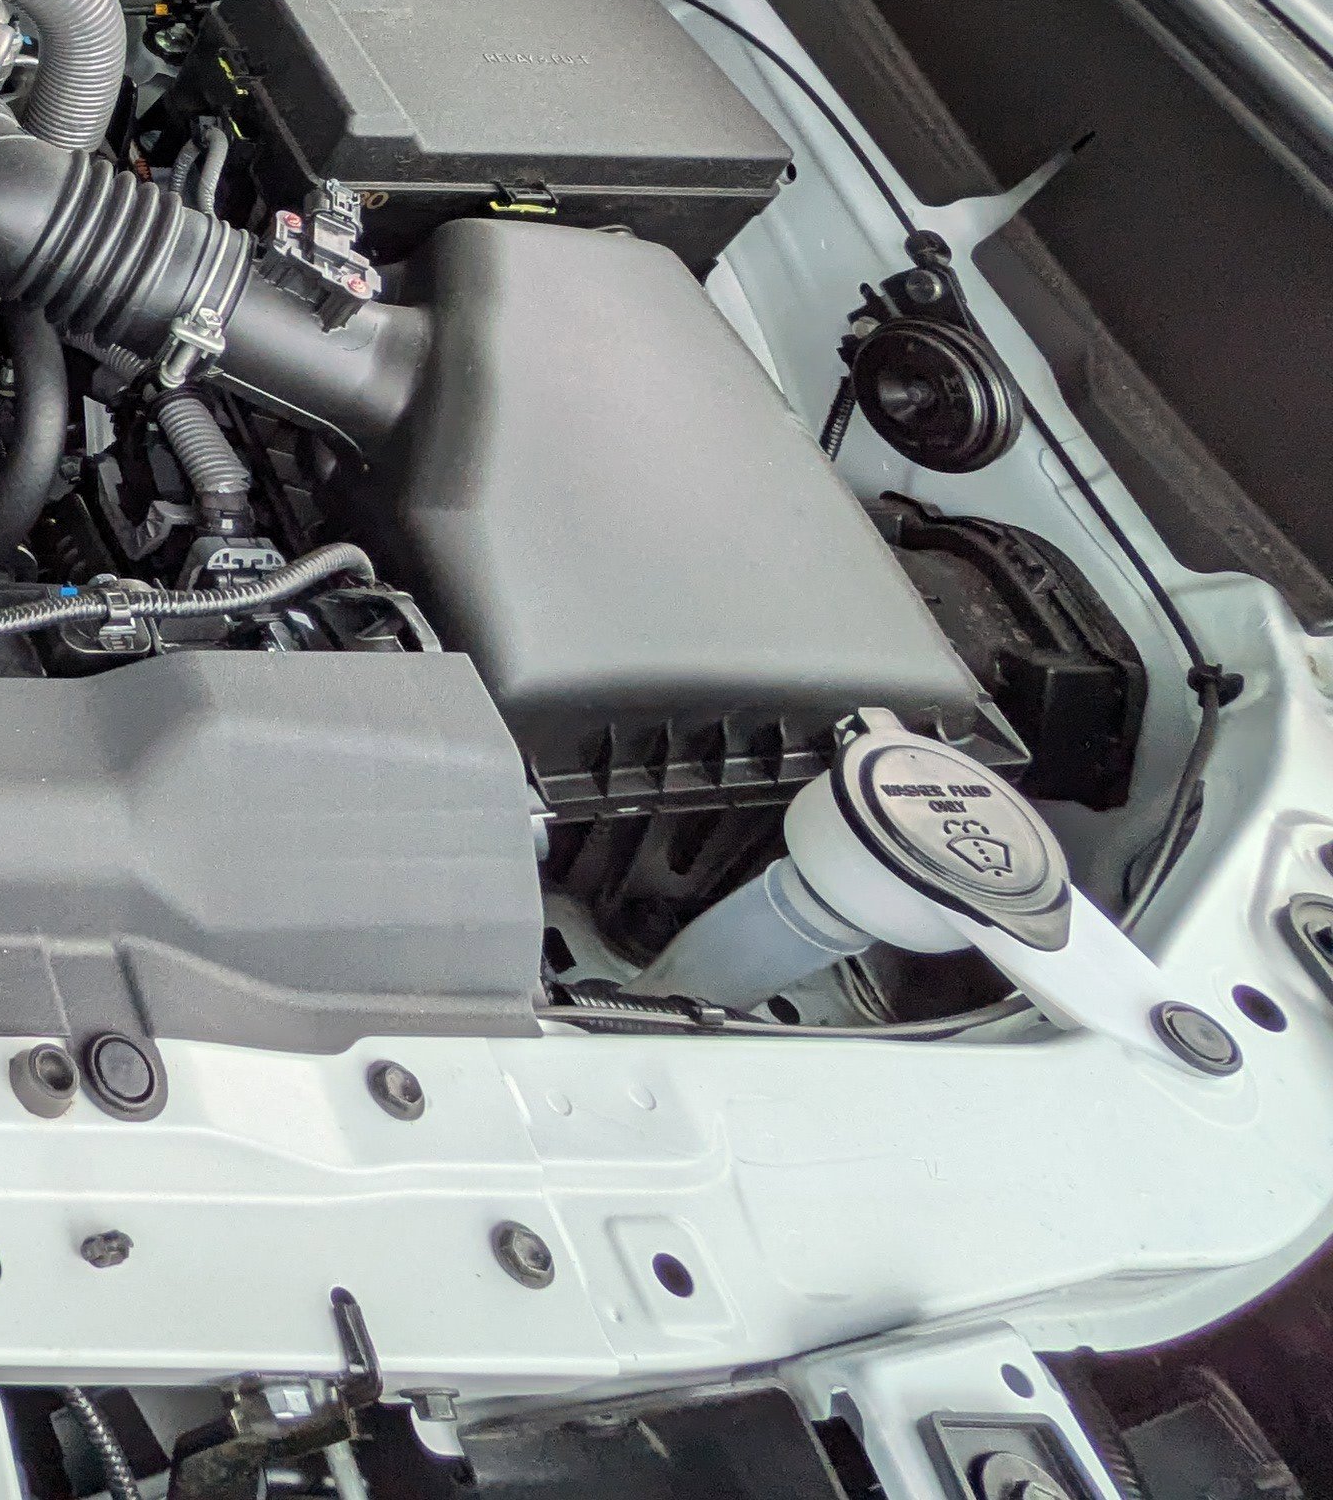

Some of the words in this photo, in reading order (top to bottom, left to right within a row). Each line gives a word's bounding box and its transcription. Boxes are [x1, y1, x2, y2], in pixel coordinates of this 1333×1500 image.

[550, 54, 591, 65] FUE
[879, 784, 945, 798] WASHER
[947, 784, 992, 798] FLUID
[927, 800, 968, 814] ONLY
